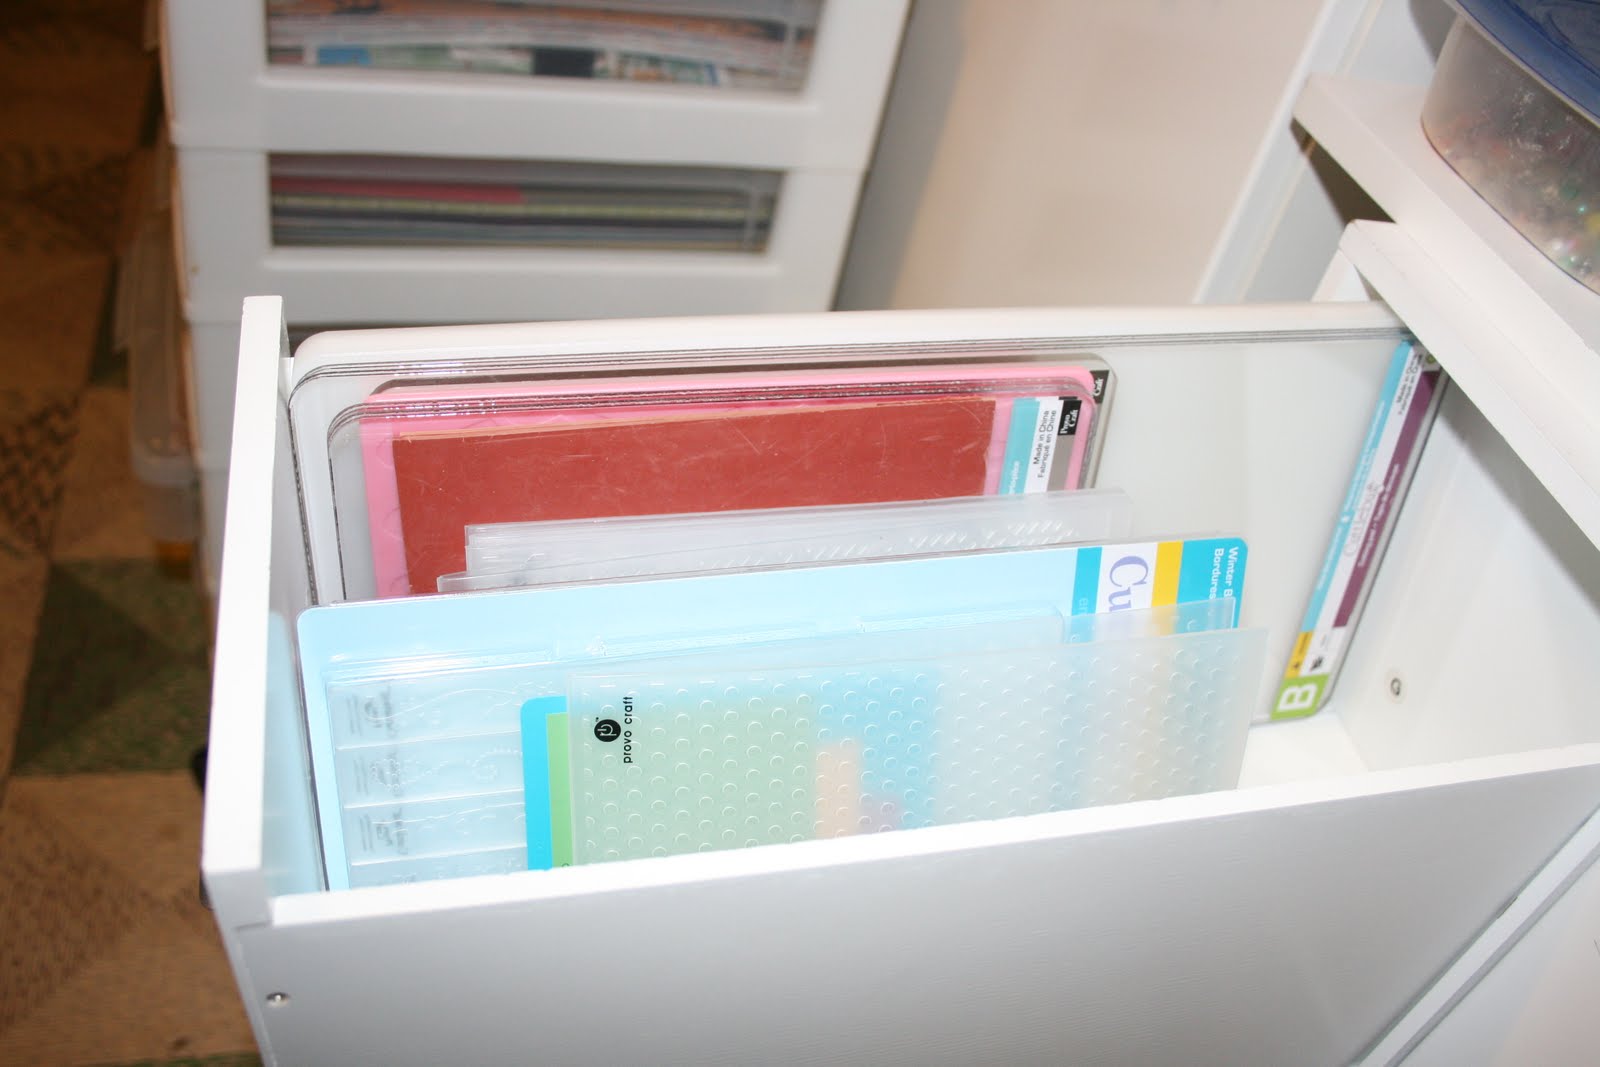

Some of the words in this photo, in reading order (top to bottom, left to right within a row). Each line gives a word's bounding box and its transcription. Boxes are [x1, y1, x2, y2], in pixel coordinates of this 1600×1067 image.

[1040, 410, 1050, 433] China
[1047, 410, 1057, 432] Chine
[1039, 433, 1045, 441] in
[1046, 433, 1052, 443] en
[1033, 442, 1043, 465] Made
[1209, 548, 1225, 600] Bordures
[1225, 546, 1240, 587] Winter
[622, 696, 634, 725] craft
[1276, 683, 1318, 713] B
[623, 730, 634, 764] provo
